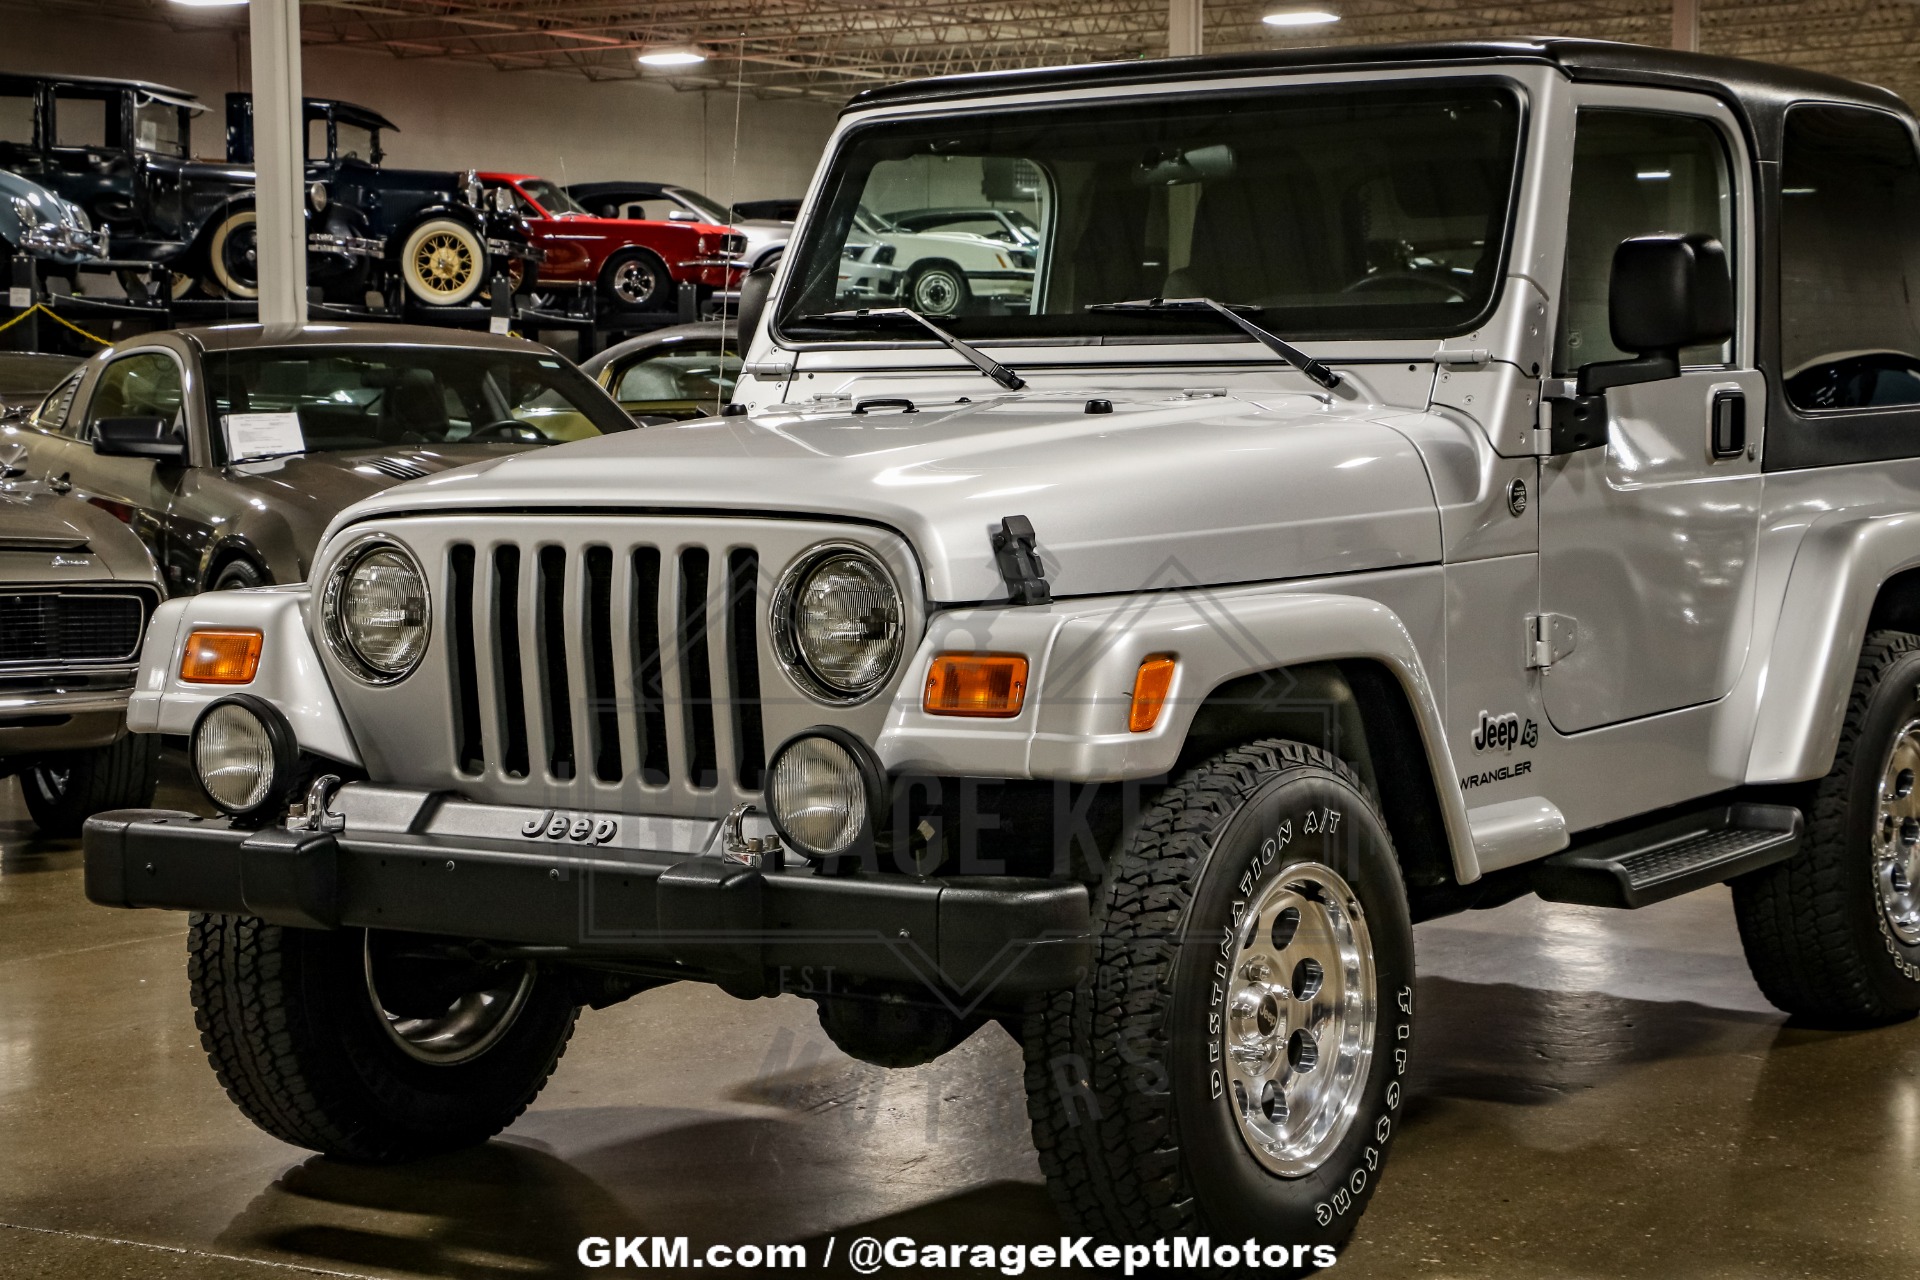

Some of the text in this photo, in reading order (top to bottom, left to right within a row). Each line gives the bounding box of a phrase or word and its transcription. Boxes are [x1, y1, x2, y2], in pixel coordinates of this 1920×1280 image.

[1474, 717, 1519, 751] Jeep
[1459, 761, 1532, 791] WRANGLER
[522, 809, 618, 847] Jeep
[1209, 807, 1341, 1100] DESTINATION A/T
[1259, 1004, 1277, 1027] Jeep
